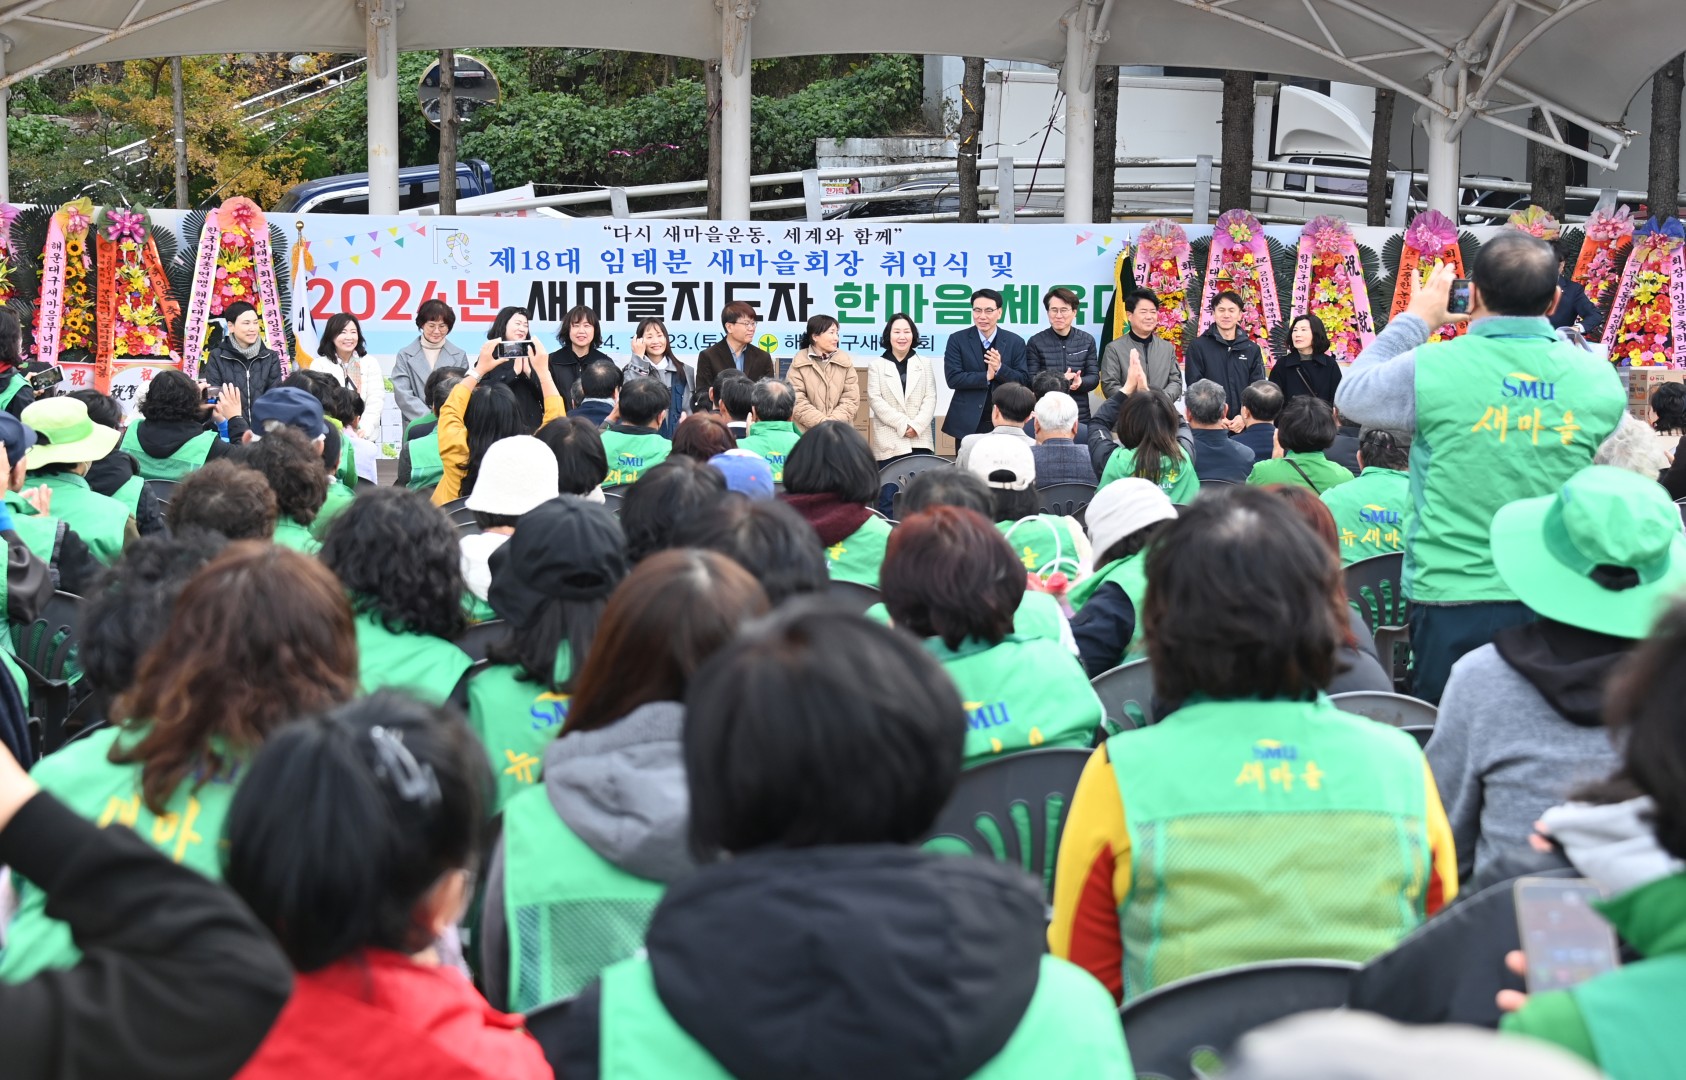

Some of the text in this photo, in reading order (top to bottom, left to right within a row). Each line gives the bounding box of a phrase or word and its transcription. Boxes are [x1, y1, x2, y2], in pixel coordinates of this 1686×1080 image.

[603, 225, 903, 245] “다시 새마을운동, 세계와 함께”
[489, 246, 1014, 278] 제18대 임태분 새마을회장 취임식 및
[307, 277, 500, 322] 2024년
[527, 280, 814, 323] 새마을지도자
[834, 281, 973, 325] 한마음
[1501, 376, 1555, 400] SMU
[1470, 404, 1582, 446] 새마을
[617, 455, 644, 467] SMU
[603, 469, 639, 485] 새마
[1358, 507, 1399, 525] SMU
[1360, 527, 1401, 549] 새마
[963, 701, 1011, 732] MU
